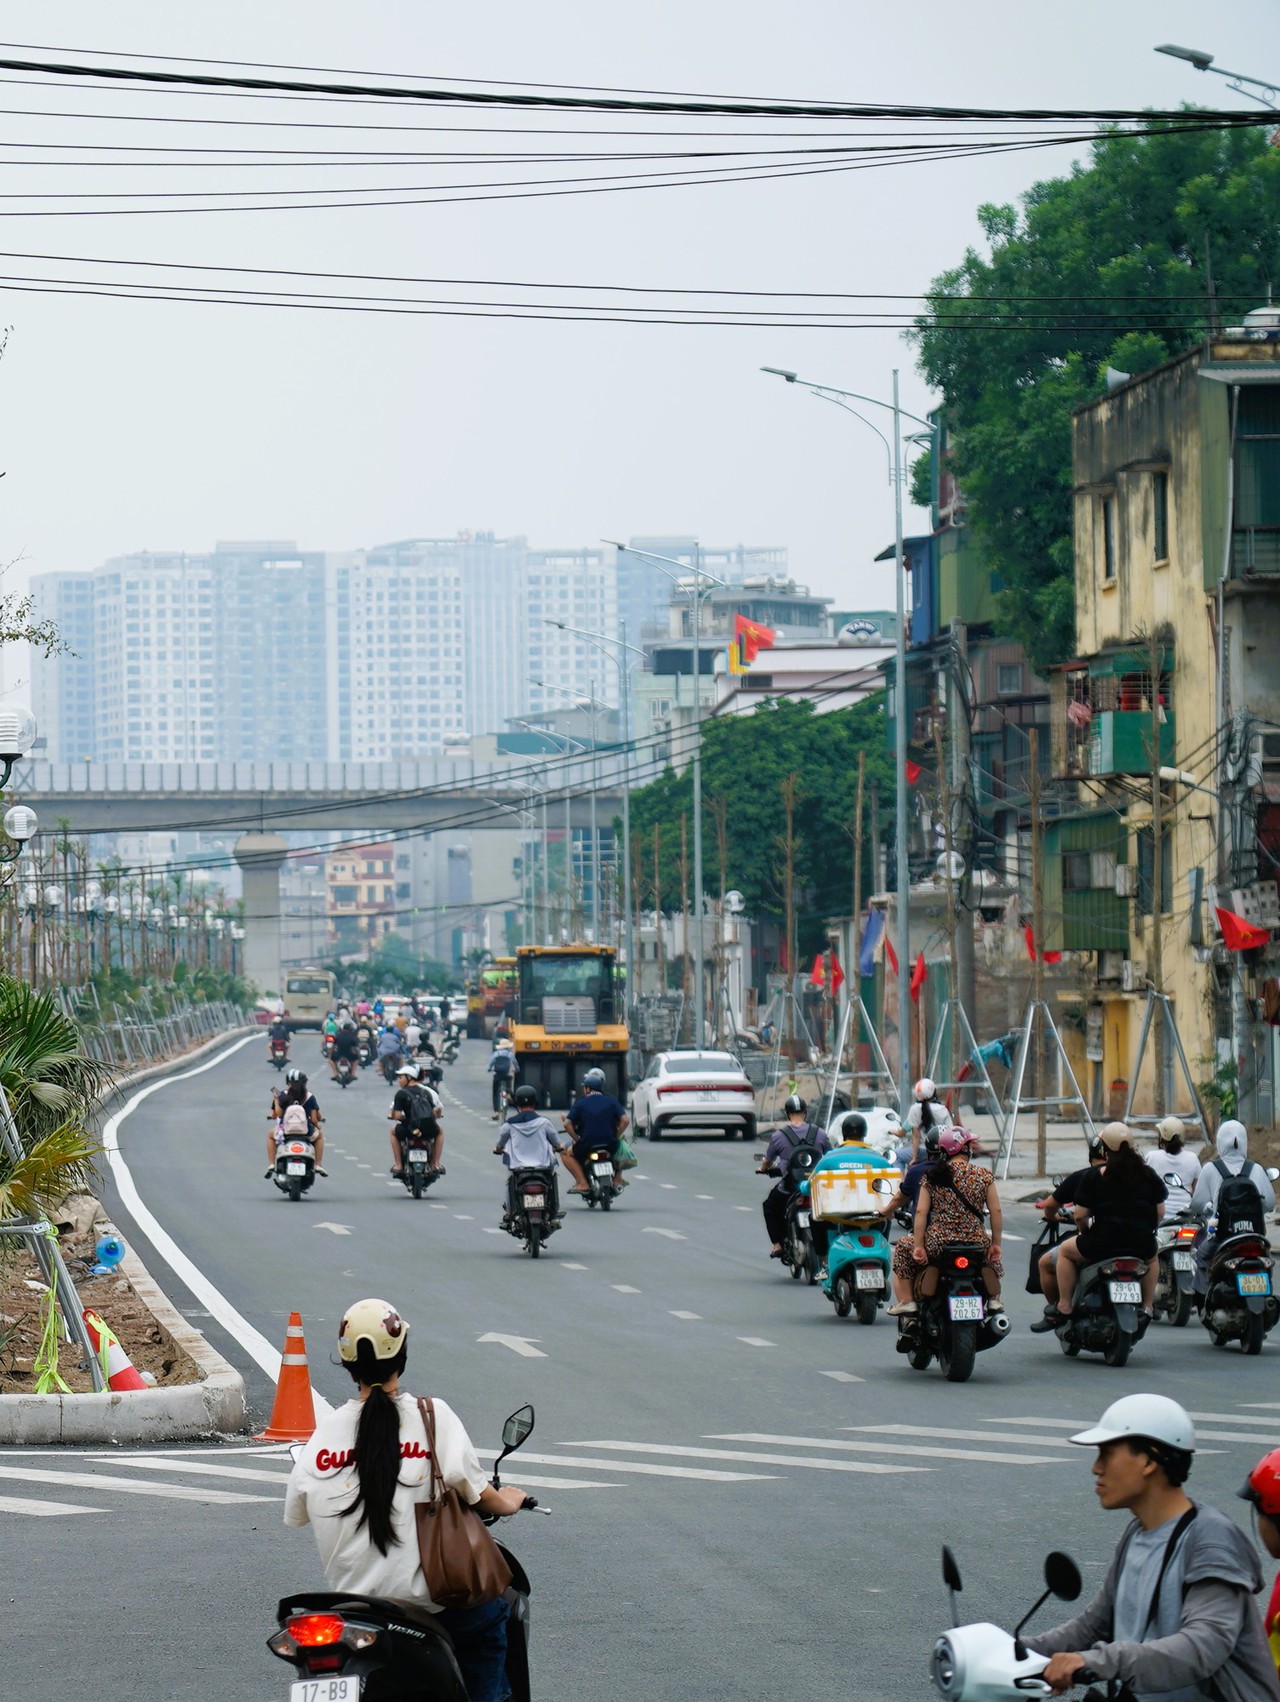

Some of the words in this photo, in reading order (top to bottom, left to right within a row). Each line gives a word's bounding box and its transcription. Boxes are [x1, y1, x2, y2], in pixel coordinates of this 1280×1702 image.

[1234, 1220, 1254, 1234] PUMA
[1113, 1292, 1140, 1302] 772.93
[953, 1309, 981, 1319] 202.67
[301, 1680, 348, 1702] 17-B9
